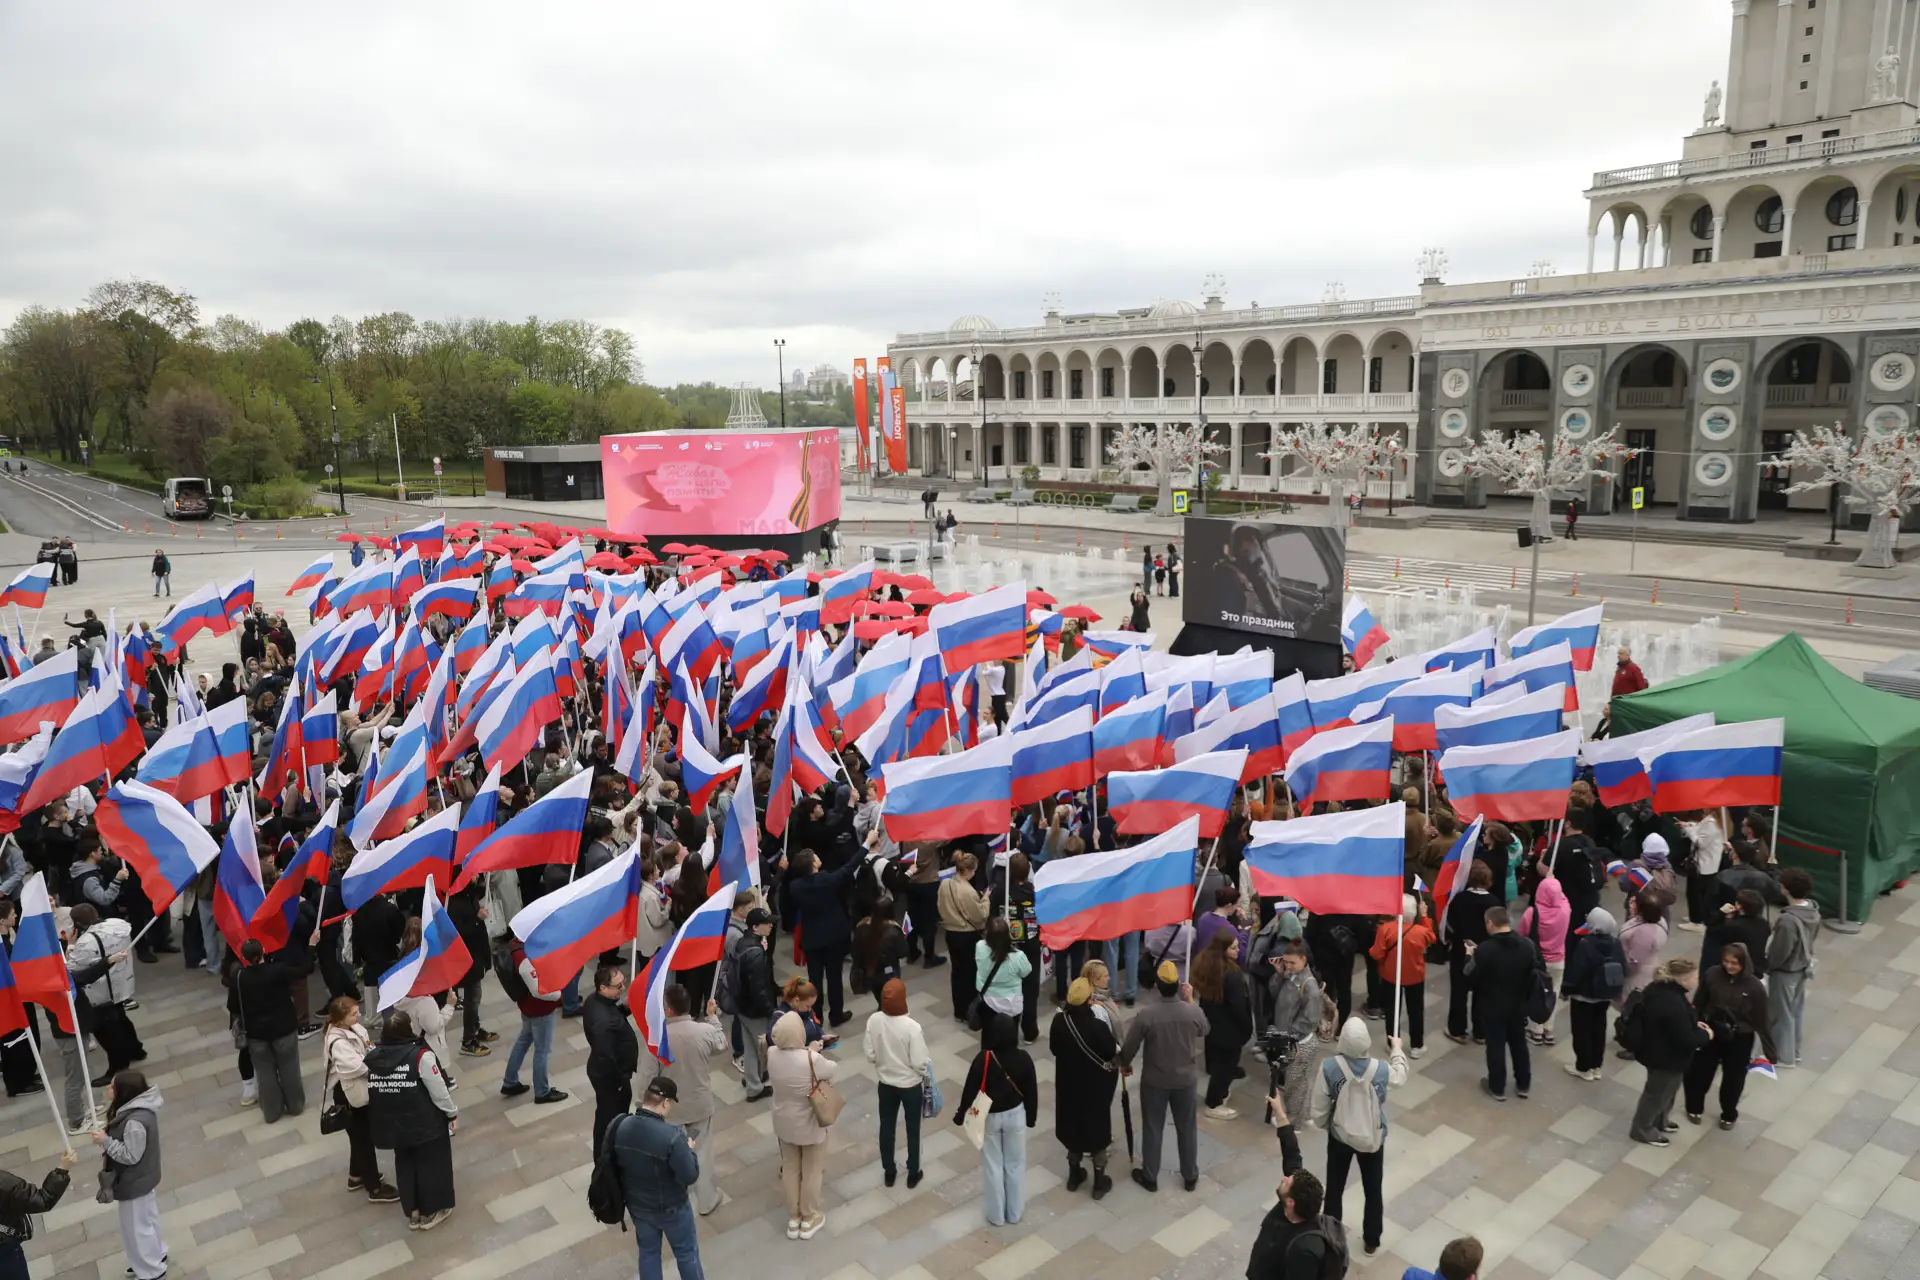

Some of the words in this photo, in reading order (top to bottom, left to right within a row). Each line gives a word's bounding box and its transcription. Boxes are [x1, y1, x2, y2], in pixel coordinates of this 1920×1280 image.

[1481, 325, 1510, 338] 1933
[1539, 321, 1625, 336] МОСКВА
[1677, 313, 1759, 329] ВОЛГА
[1819, 305, 1864, 321] 1937
[1221, 611, 1239, 622] Это
[1242, 615, 1295, 630] праздник
